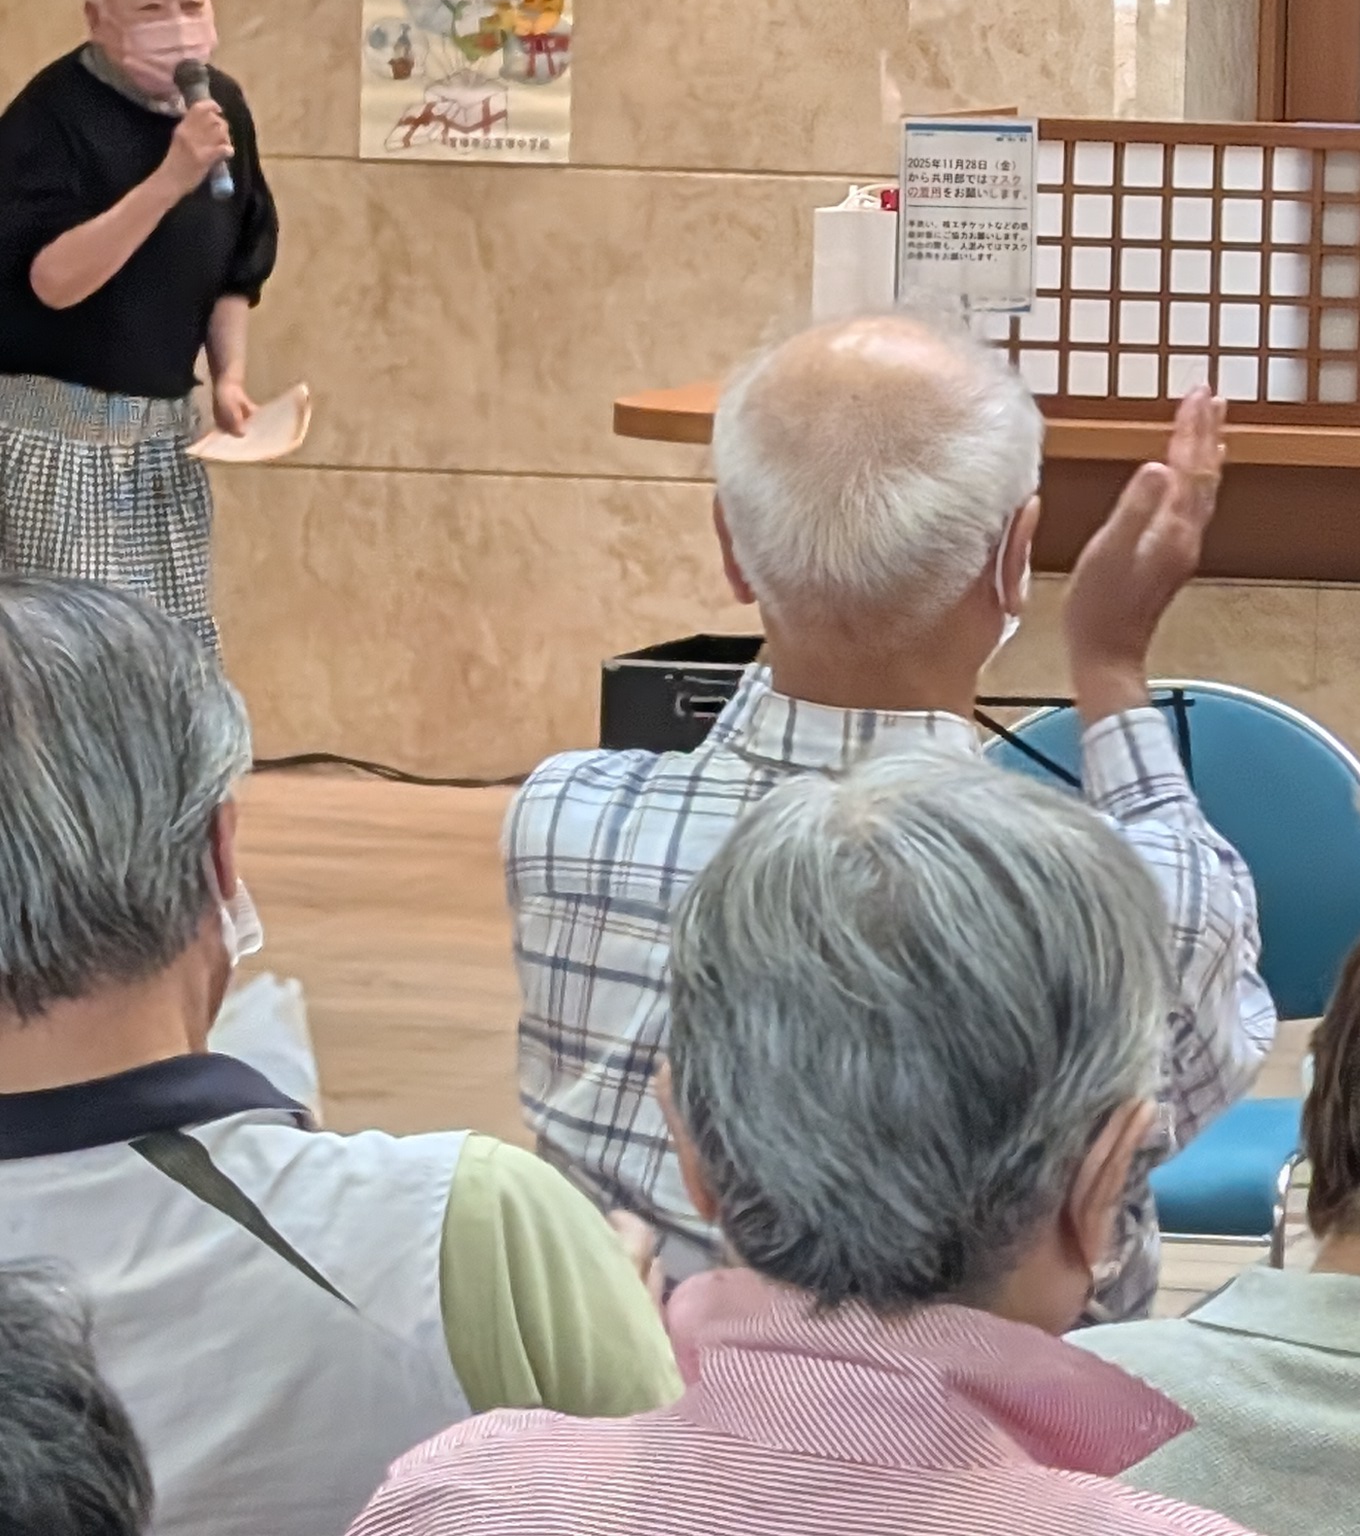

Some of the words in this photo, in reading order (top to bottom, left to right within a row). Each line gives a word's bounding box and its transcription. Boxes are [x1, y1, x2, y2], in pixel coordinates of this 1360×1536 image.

[908, 172, 1022, 185] から共用部ではマスク
